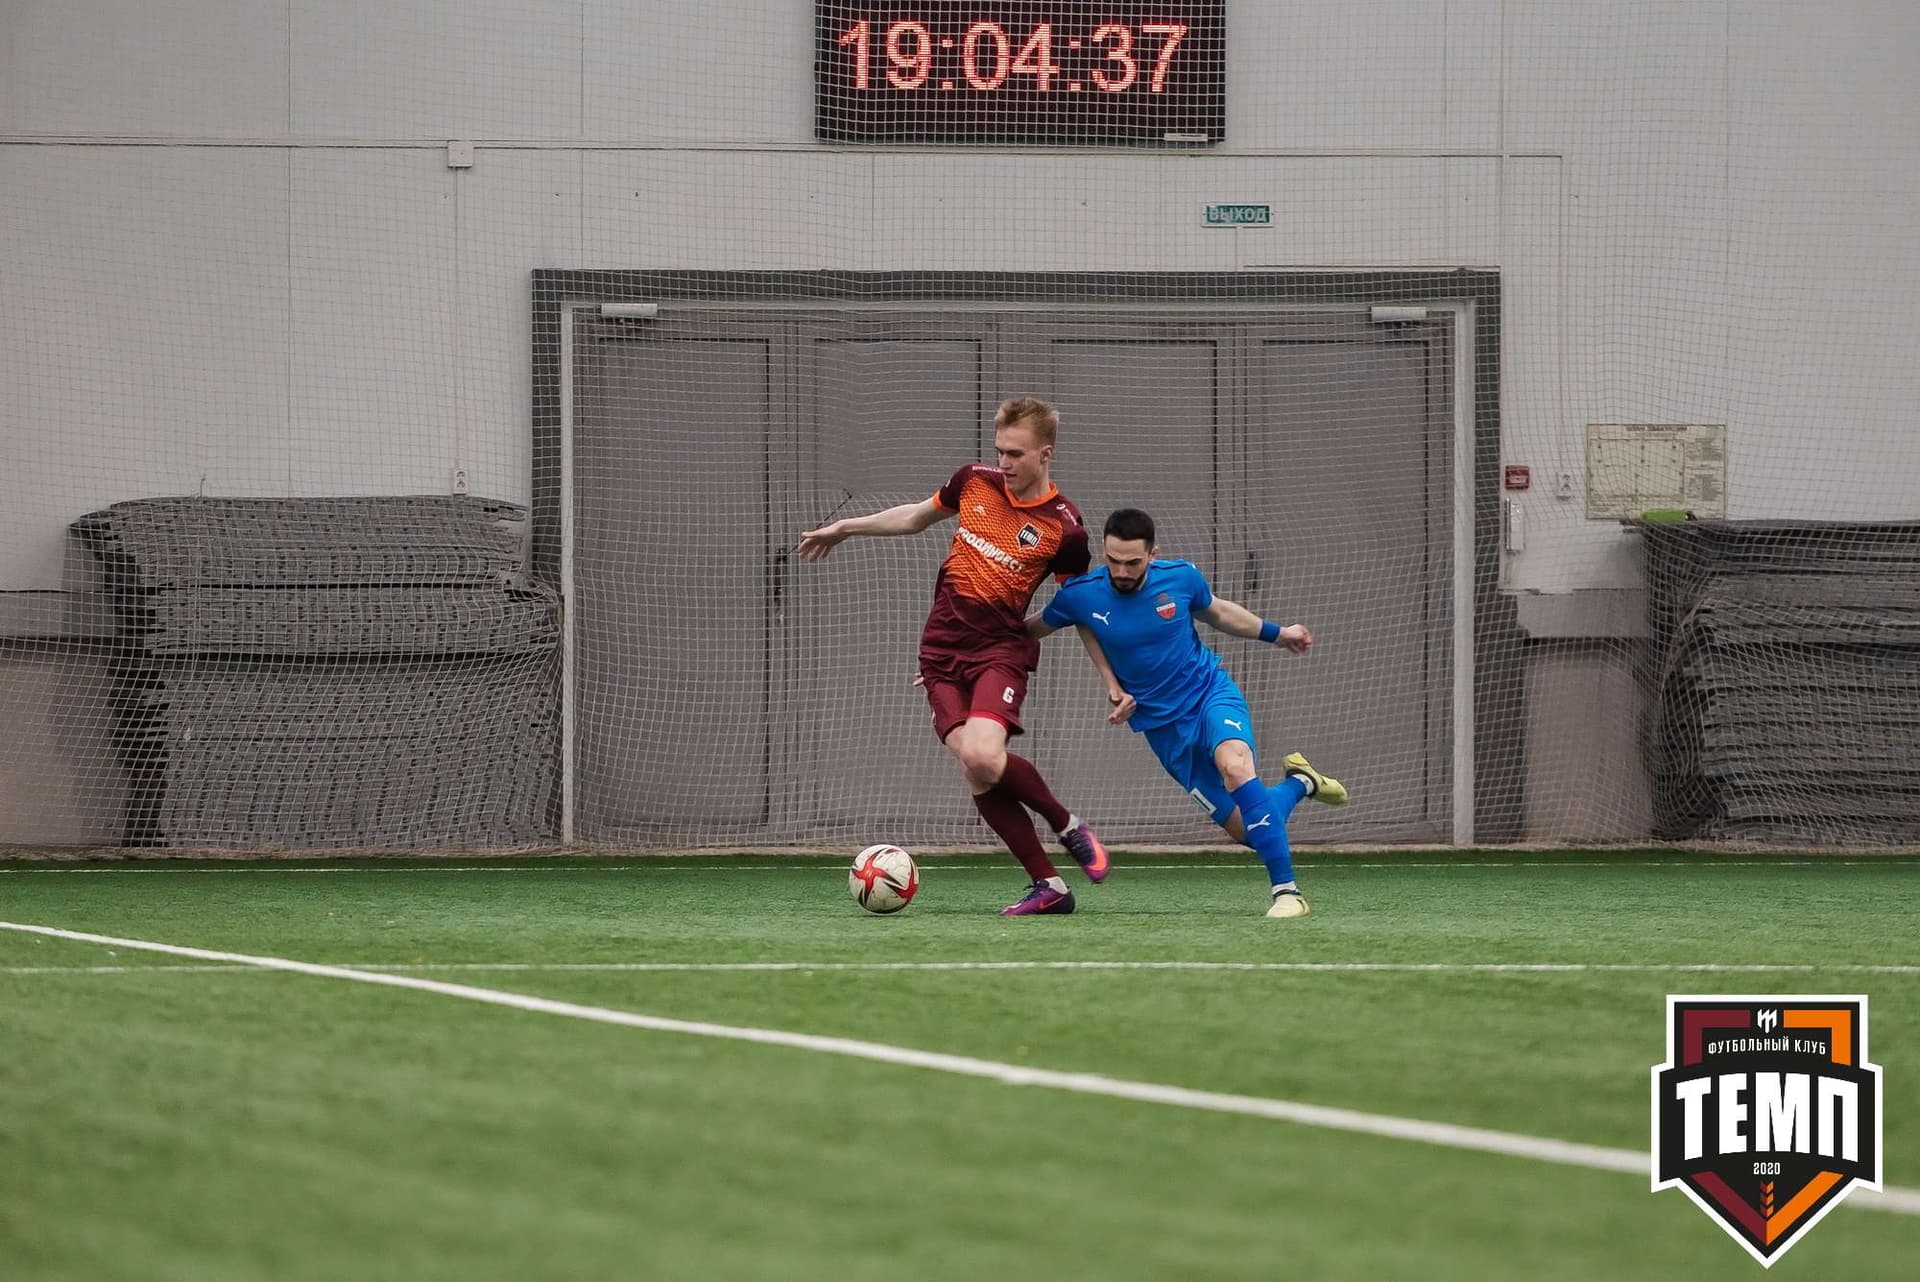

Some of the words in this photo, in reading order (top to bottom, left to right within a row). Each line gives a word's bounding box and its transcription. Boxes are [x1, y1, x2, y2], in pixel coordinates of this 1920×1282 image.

[839, 20, 1188, 93] 19:04:37
[1208, 207, 1267, 223] ВЫХОД
[1002, 686, 1015, 704] 6
